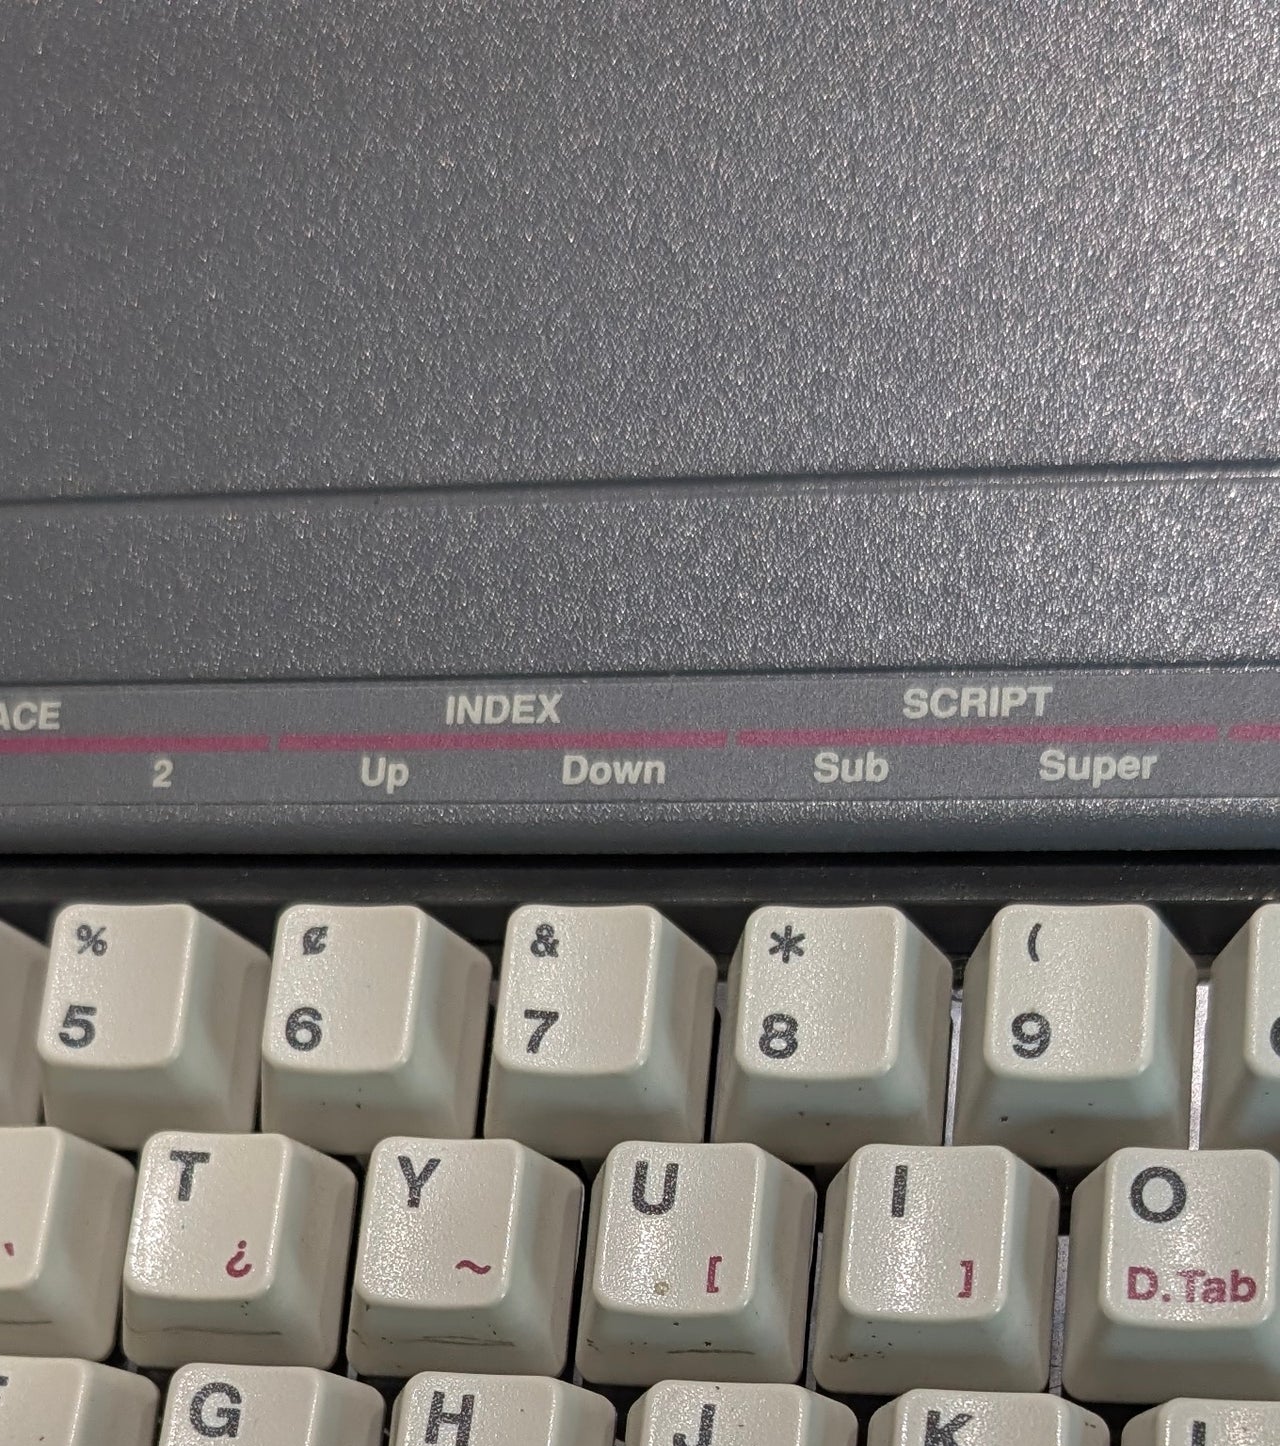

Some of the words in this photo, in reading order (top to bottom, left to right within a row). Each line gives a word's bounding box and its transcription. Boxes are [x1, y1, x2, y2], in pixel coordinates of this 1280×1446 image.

[445, 693, 563, 726] INDEX
[902, 685, 1054, 719] SCRIPT
[152, 760, 174, 788] 2
[361, 756, 409, 794] Up
[562, 755, 666, 786] Down
[813, 751, 890, 784] Sub
[1038, 749, 1158, 788] Super
[76, 924, 108, 956] %
[530, 923, 560, 958] &
[1027, 922, 1042, 962] (
[58, 1004, 97, 1048] 5
[285, 1006, 323, 1052] 6
[523, 1009, 560, 1054] 7
[758, 1013, 799, 1060] 8
[1011, 1011, 1051, 1059] 9
[169, 1150, 211, 1202] T
[397, 1155, 441, 1209] Y
[631, 1161, 679, 1216] U
[890, 1164, 908, 1218] I
[1129, 1166, 1187, 1224] O
[706, 1255, 723, 1294] [
[957, 1260, 974, 1299] ]
[189, 1382, 242, 1438] G
